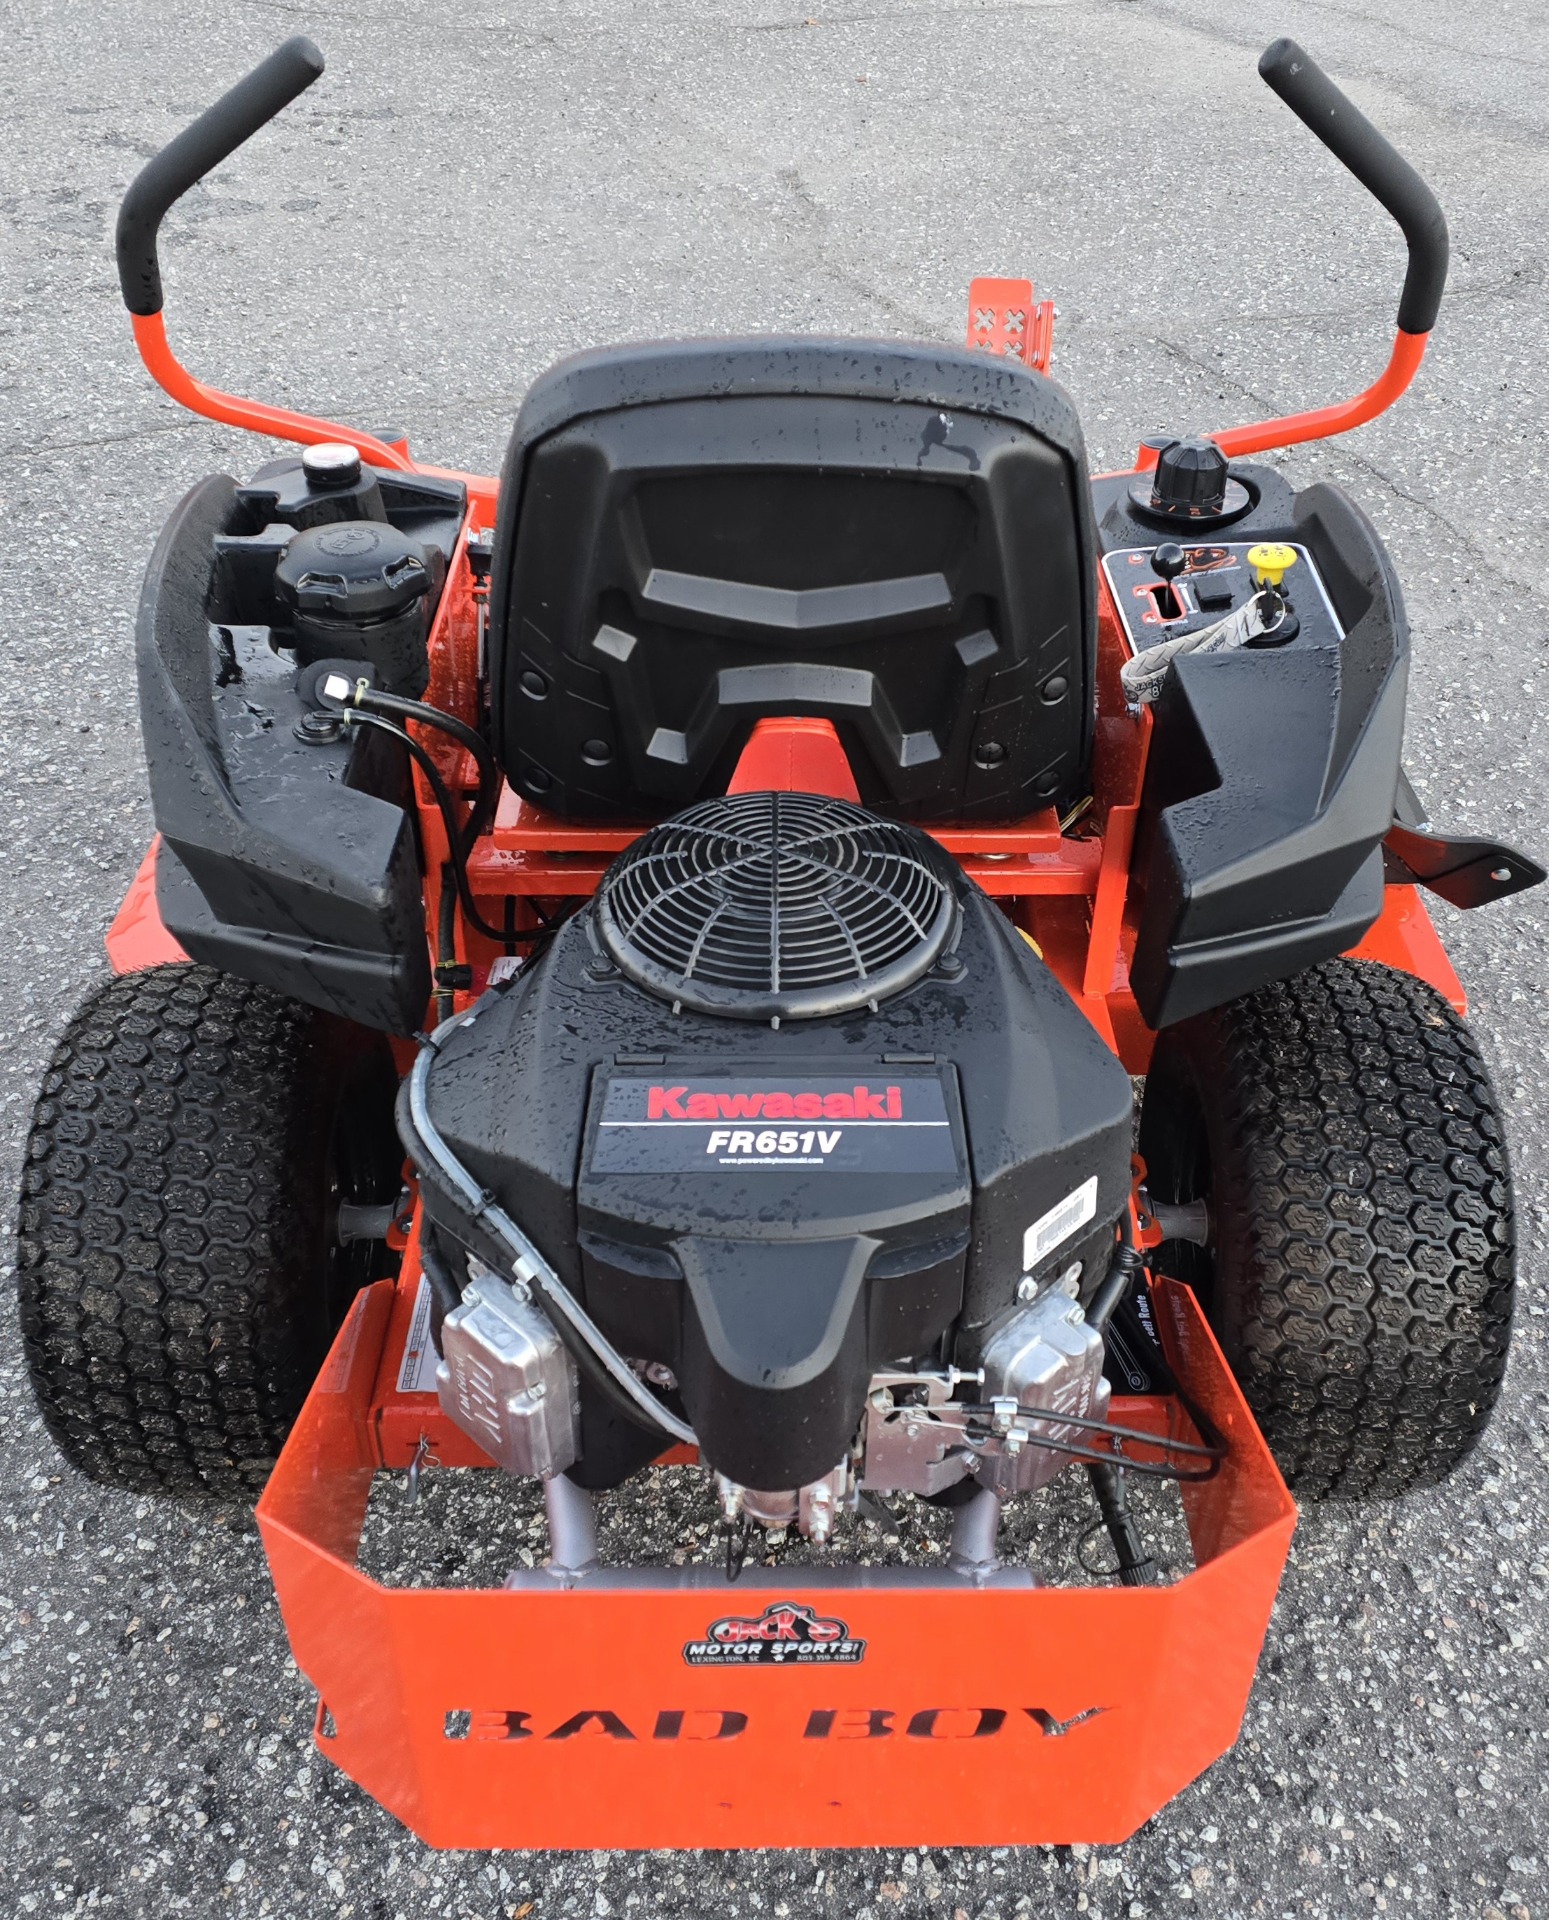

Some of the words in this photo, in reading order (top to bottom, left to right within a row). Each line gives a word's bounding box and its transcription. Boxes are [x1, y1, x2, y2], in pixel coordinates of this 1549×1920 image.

[1135, 674, 1166, 691] JACKS
[647, 1085, 903, 1120] Kawasaki
[706, 1130, 843, 1155] FR651V
[1136, 1294, 1151, 1319] Route
[689, 1642, 763, 1655] MOTOR
[770, 1642, 859, 1655] SPORTS!
[749, 1655, 760, 1663] SC
[443, 1709, 749, 1741] BAD
[803, 1707, 1112, 1740] BOY
